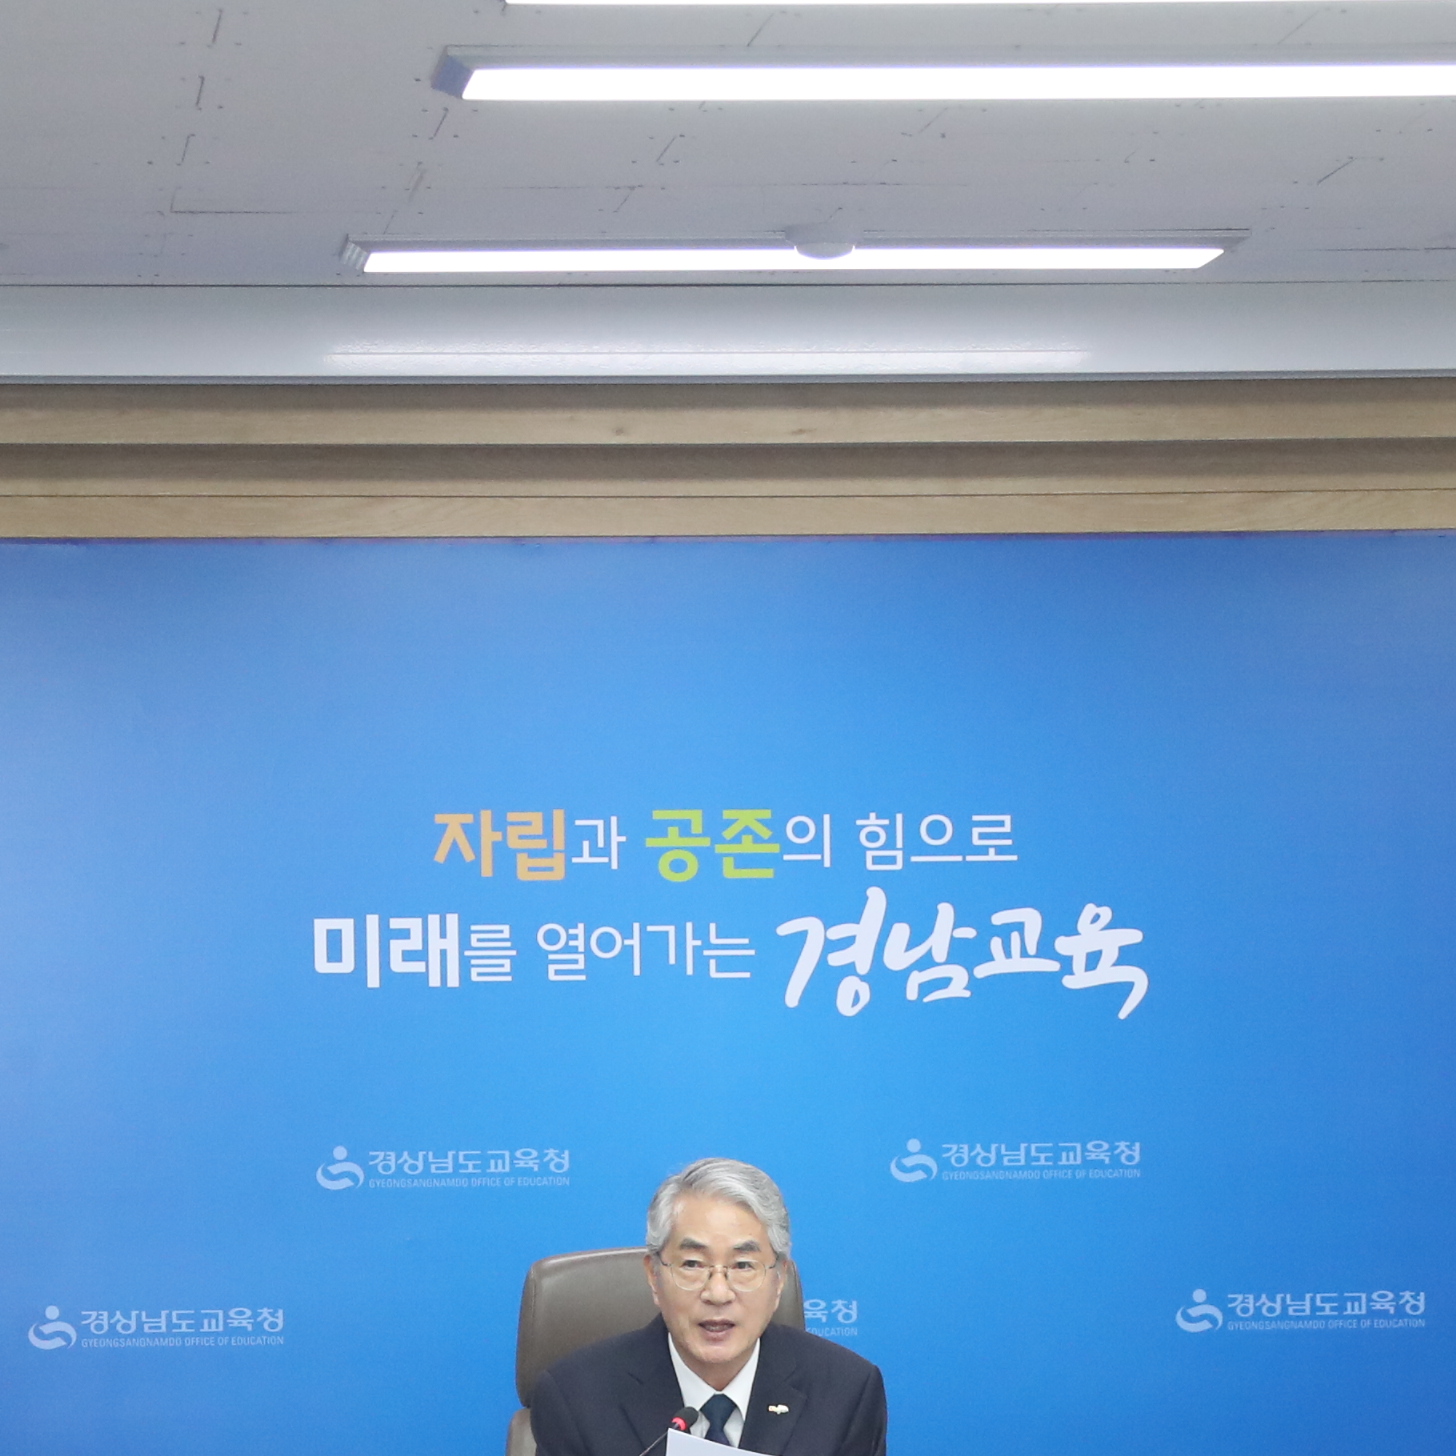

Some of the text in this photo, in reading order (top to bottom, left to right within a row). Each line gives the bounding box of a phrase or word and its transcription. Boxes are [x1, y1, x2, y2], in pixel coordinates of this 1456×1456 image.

[433, 808, 1019, 883] 자립과 공존의 힘으로
[313, 886, 1149, 1020] 미래를 열어가는 경남교육
[369, 1148, 570, 1175] 경상남도교육청
[942, 1140, 1141, 1167] 경상남도교육청
[471, 1176, 501, 1187] OFFICE
[504, 1176, 516, 1187] OF
[518, 1175, 570, 1186] EDUCATION
[1043, 1169, 1073, 1180] OFFICE
[1075, 1169, 1087, 1180] OF
[1089, 1168, 1141, 1179] EDUCATION
[1228, 1290, 1426, 1317] 경상남도교육청
[81, 1307, 284, 1334] 경상남도교육청
[1328, 1319, 1358, 1330] OFFICE
[1360, 1318, 1372, 1329] OF
[1374, 1317, 1426, 1329] EDUCATION
[184, 1336, 215, 1348] OFFICE
[217, 1336, 229, 1347] OF
[231, 1335, 284, 1346] EDUCATION
